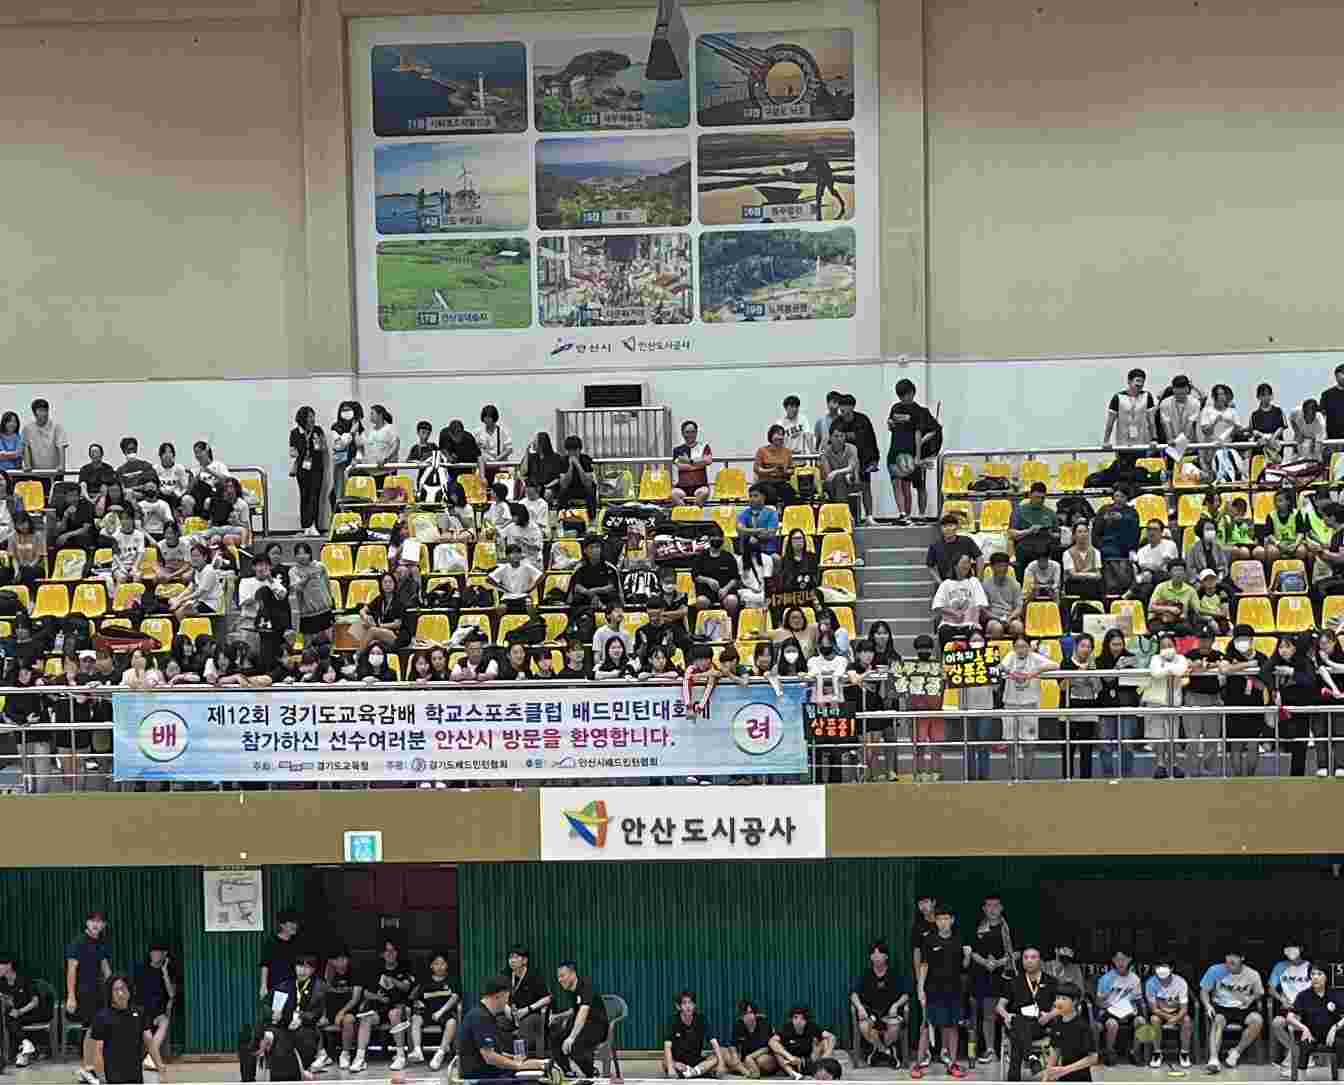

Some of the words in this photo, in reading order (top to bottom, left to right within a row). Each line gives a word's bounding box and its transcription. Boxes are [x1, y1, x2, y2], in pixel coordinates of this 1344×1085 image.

[207, 704, 271, 727] 제12회
[279, 703, 417, 727] 경기도교육감배
[424, 701, 563, 724] 학교스포츠클럽
[151, 723, 177, 747] 배
[241, 729, 319, 753] 참가하신
[328, 729, 427, 752] 선수여러분
[434, 729, 493, 751] 안산시
[501, 727, 561, 750] 방문을
[570, 726, 676, 748] 환영합니다.
[745, 714, 770, 742] 려
[620, 814, 796, 846] 안산도시공사
